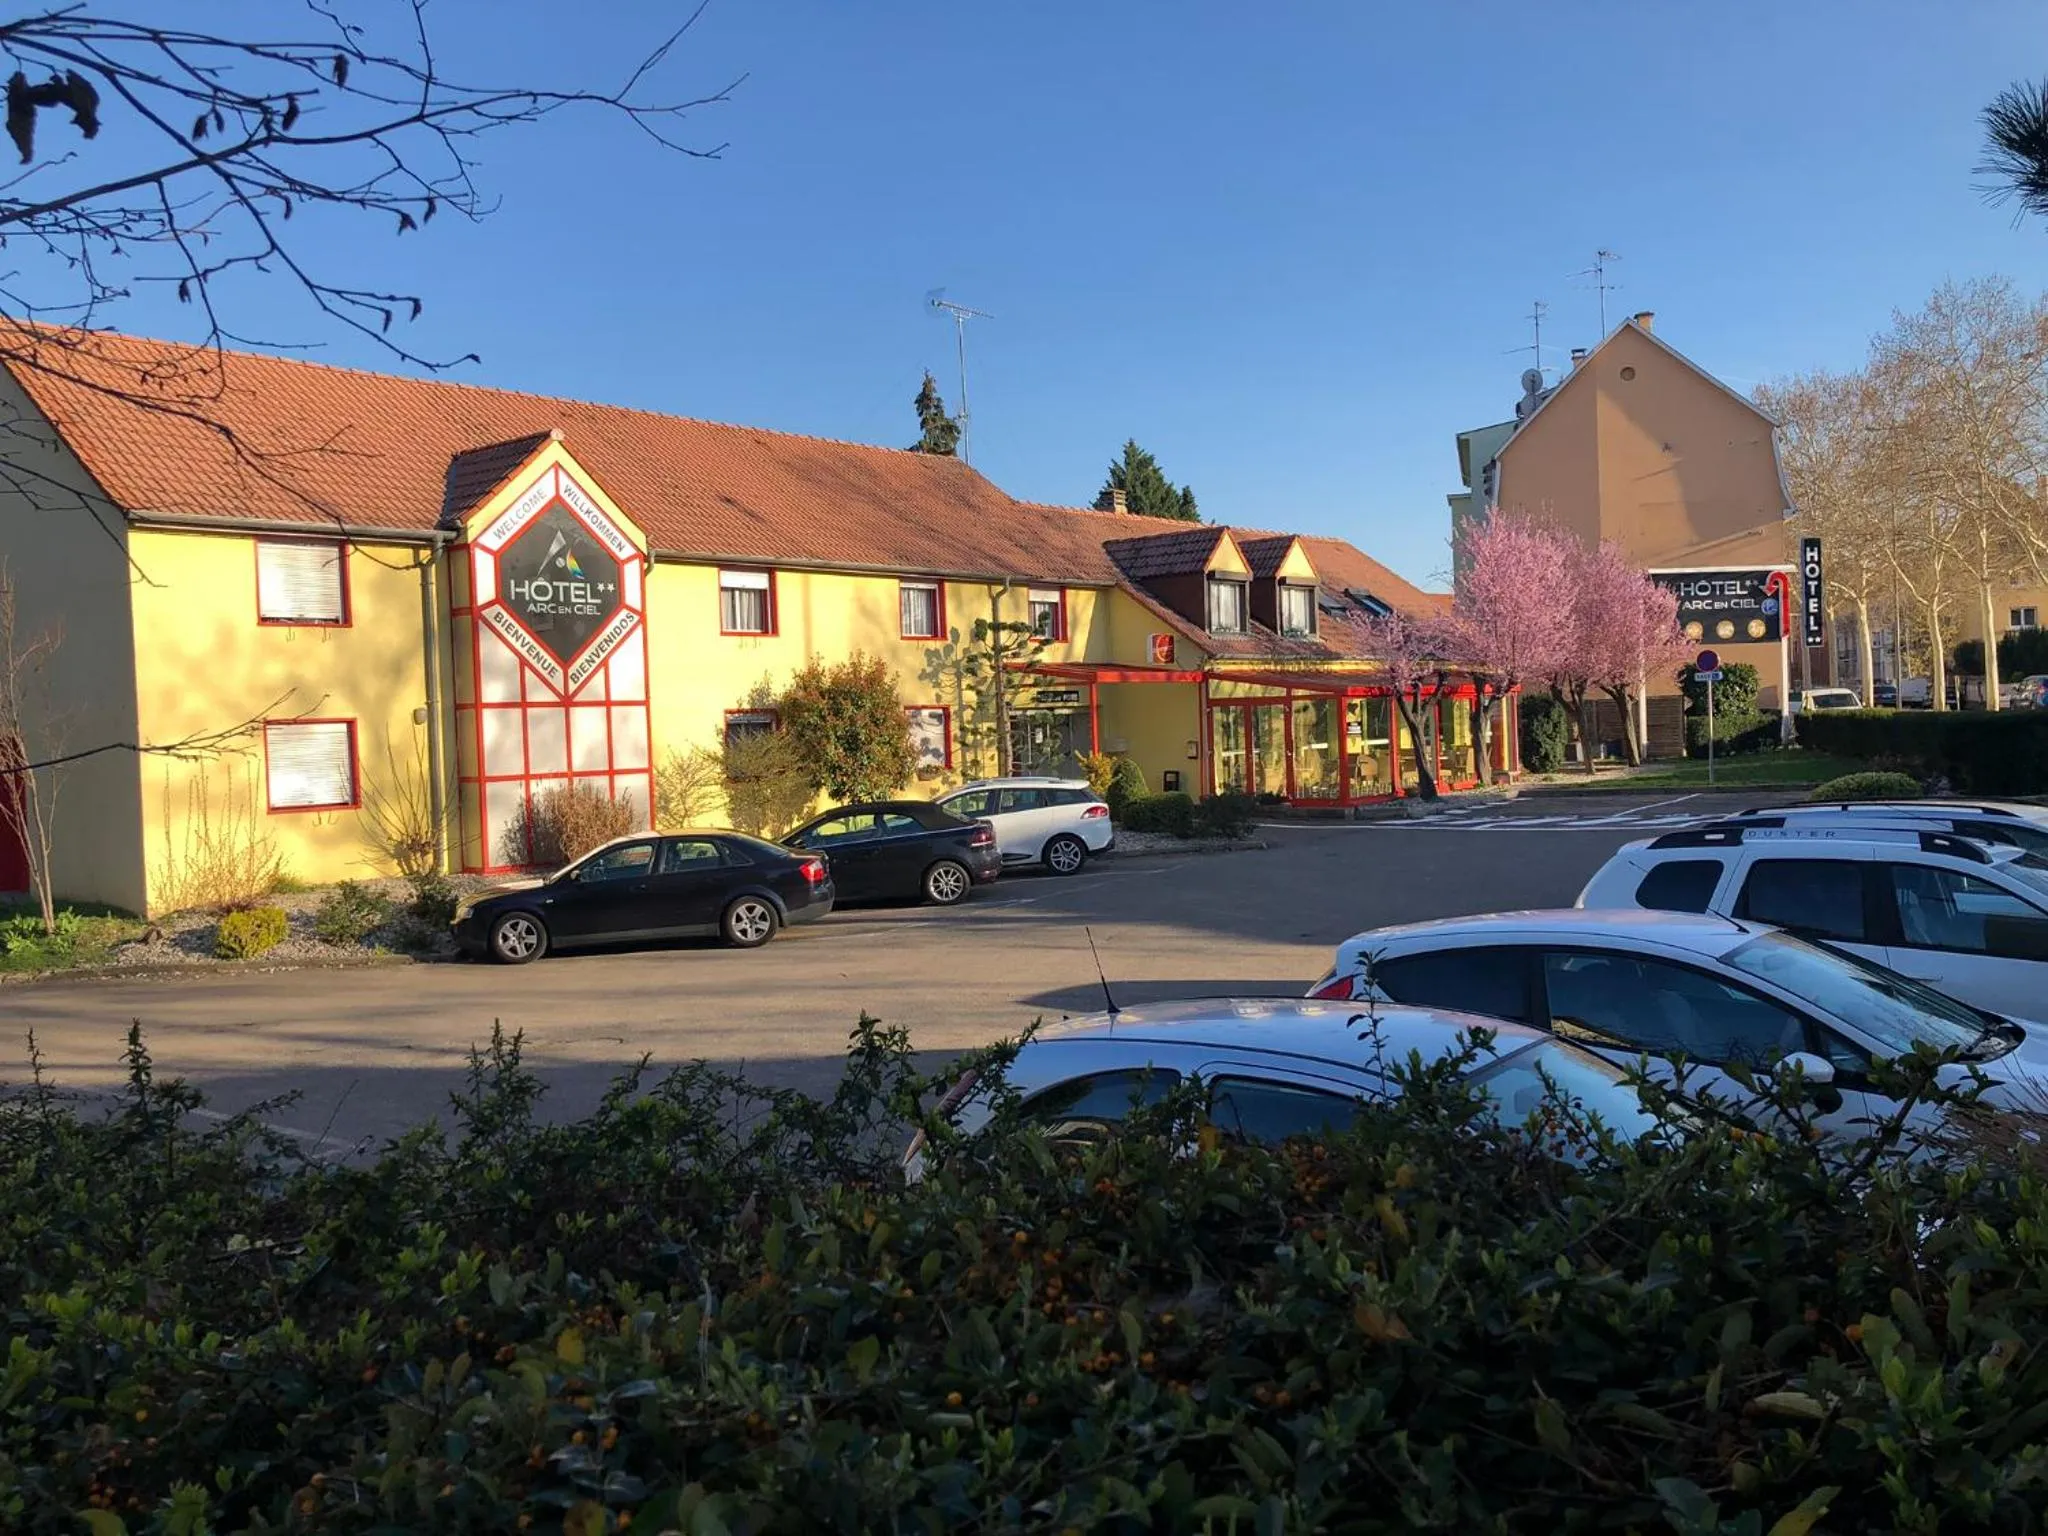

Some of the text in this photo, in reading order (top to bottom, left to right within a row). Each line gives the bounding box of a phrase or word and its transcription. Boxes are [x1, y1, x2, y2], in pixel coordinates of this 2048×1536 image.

[493, 487, 547, 540] WELCOME
[563, 484, 626, 553] WILLKOMMEN
[526, 603, 601, 615] ARC EN CIEL
[1680, 580, 1748, 596] HÔTEL
[1682, 600, 1712, 610] ARC
[1714, 601, 1728, 609] EN
[1731, 598, 1759, 608] CIEL
[1805, 547, 1819, 631] HOTEL
[493, 610, 558, 679] BIENVENUE
[569, 612, 635, 684] BIENVENIDOS
